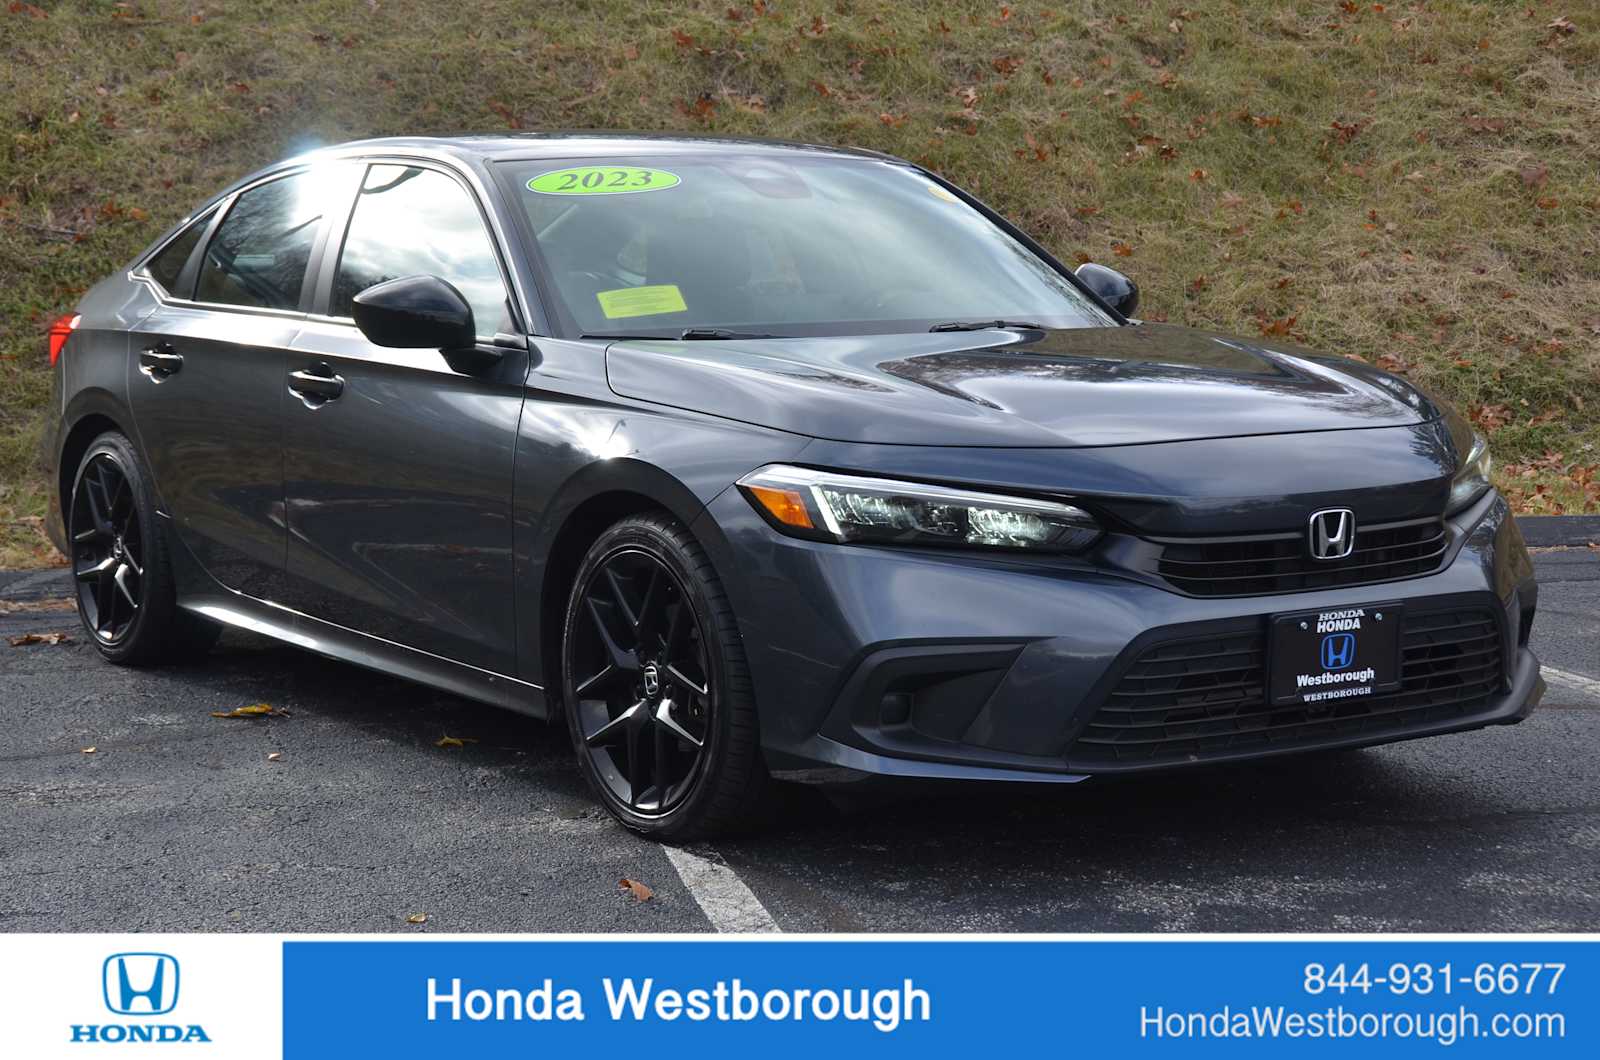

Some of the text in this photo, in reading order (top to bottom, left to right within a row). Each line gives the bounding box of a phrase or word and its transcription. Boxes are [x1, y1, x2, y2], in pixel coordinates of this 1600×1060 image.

[557, 171, 653, 190] 2023
[1319, 609, 1365, 621] HONDA
[1317, 618, 1361, 633] HONDA
[1297, 668, 1375, 687] Westborough
[1303, 687, 1371, 702] WESTBOROUGH
